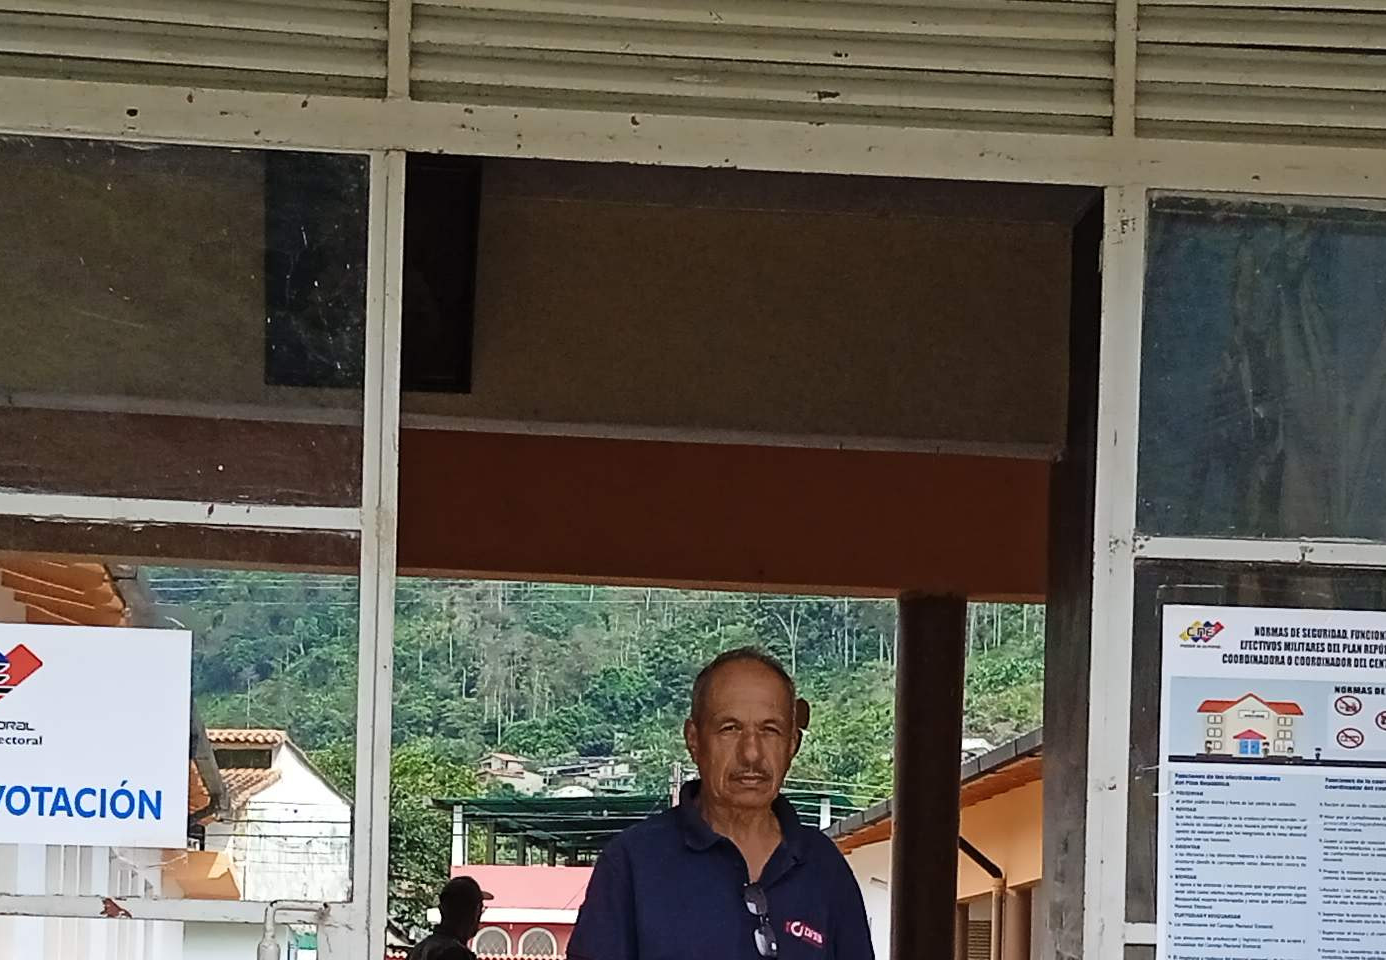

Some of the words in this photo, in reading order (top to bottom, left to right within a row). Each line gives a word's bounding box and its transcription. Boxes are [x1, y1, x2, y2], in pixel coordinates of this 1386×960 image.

[1186, 626, 1215, 638] CNE
[1254, 626, 1289, 638] NORMAS
[1290, 627, 1301, 638] DE
[1240, 640, 1282, 652] EFECTIVOS
[1283, 641, 1325, 653] MILITARES
[1327, 643, 1341, 653] DEL
[1342, 643, 1362, 654] PLAN
[1222, 653, 1286, 665] COORDINADORA
[1287, 655, 1293, 666] O
[1294, 656, 1352, 668] COORDINADOR
[1353, 658, 1367, 668] DEL
[1334, 686, 1373, 695] NORMAS
[1374, 687, 1385, 695] DE
